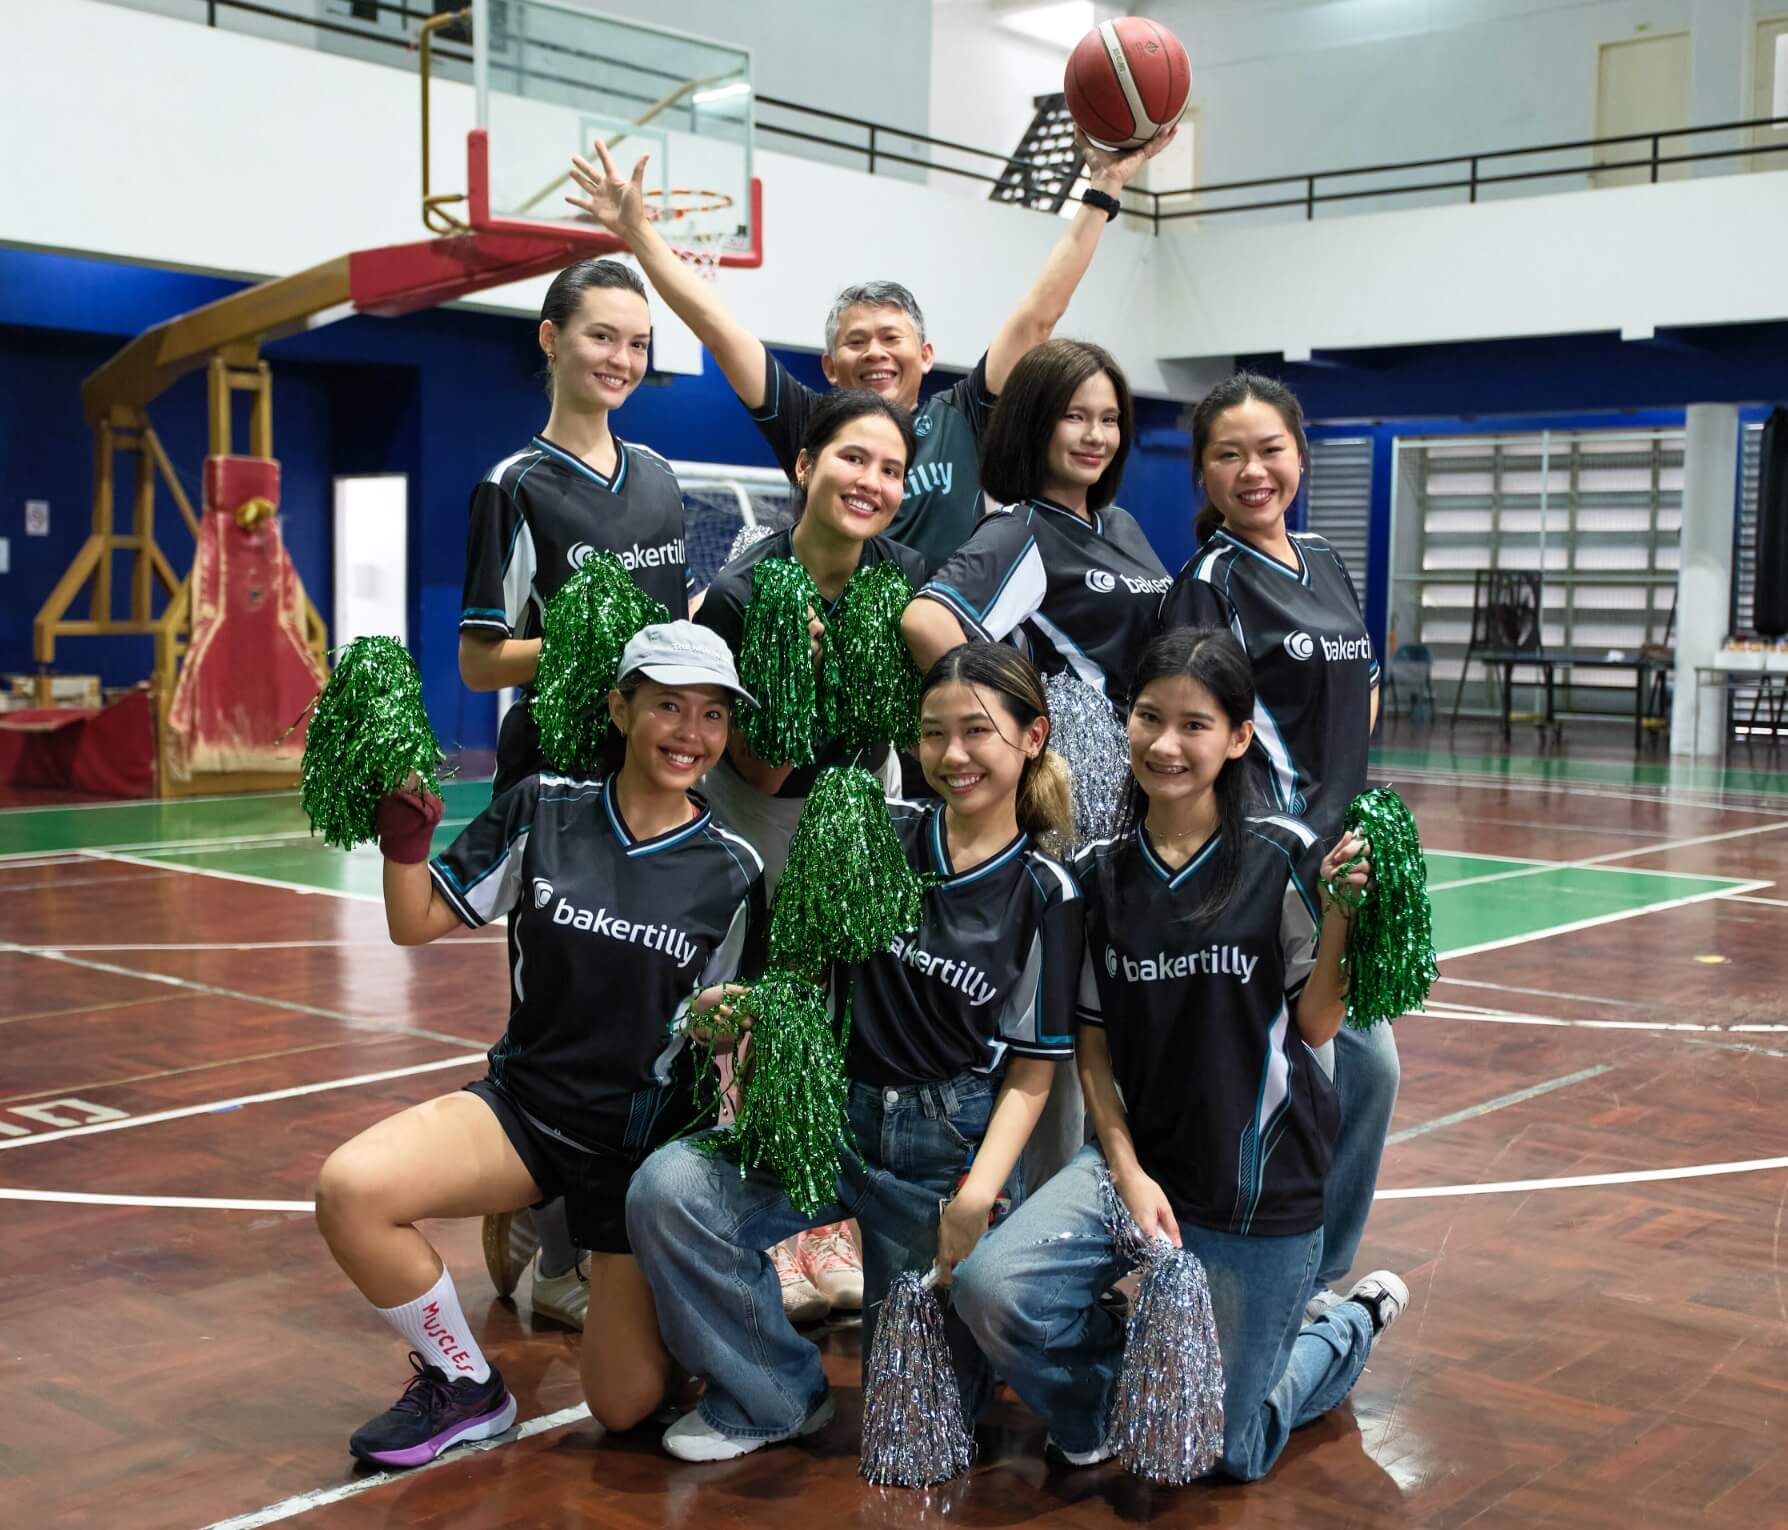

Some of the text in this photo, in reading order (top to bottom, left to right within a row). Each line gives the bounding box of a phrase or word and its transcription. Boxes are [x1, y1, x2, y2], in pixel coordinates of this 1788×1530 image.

[616, 538, 686, 571] akertill
[552, 897, 698, 968] bakertilly
[1122, 944, 1259, 984] bakertilly
[889, 935, 998, 1006] akertilly
[422, 1301, 474, 1372] MUSCLES
